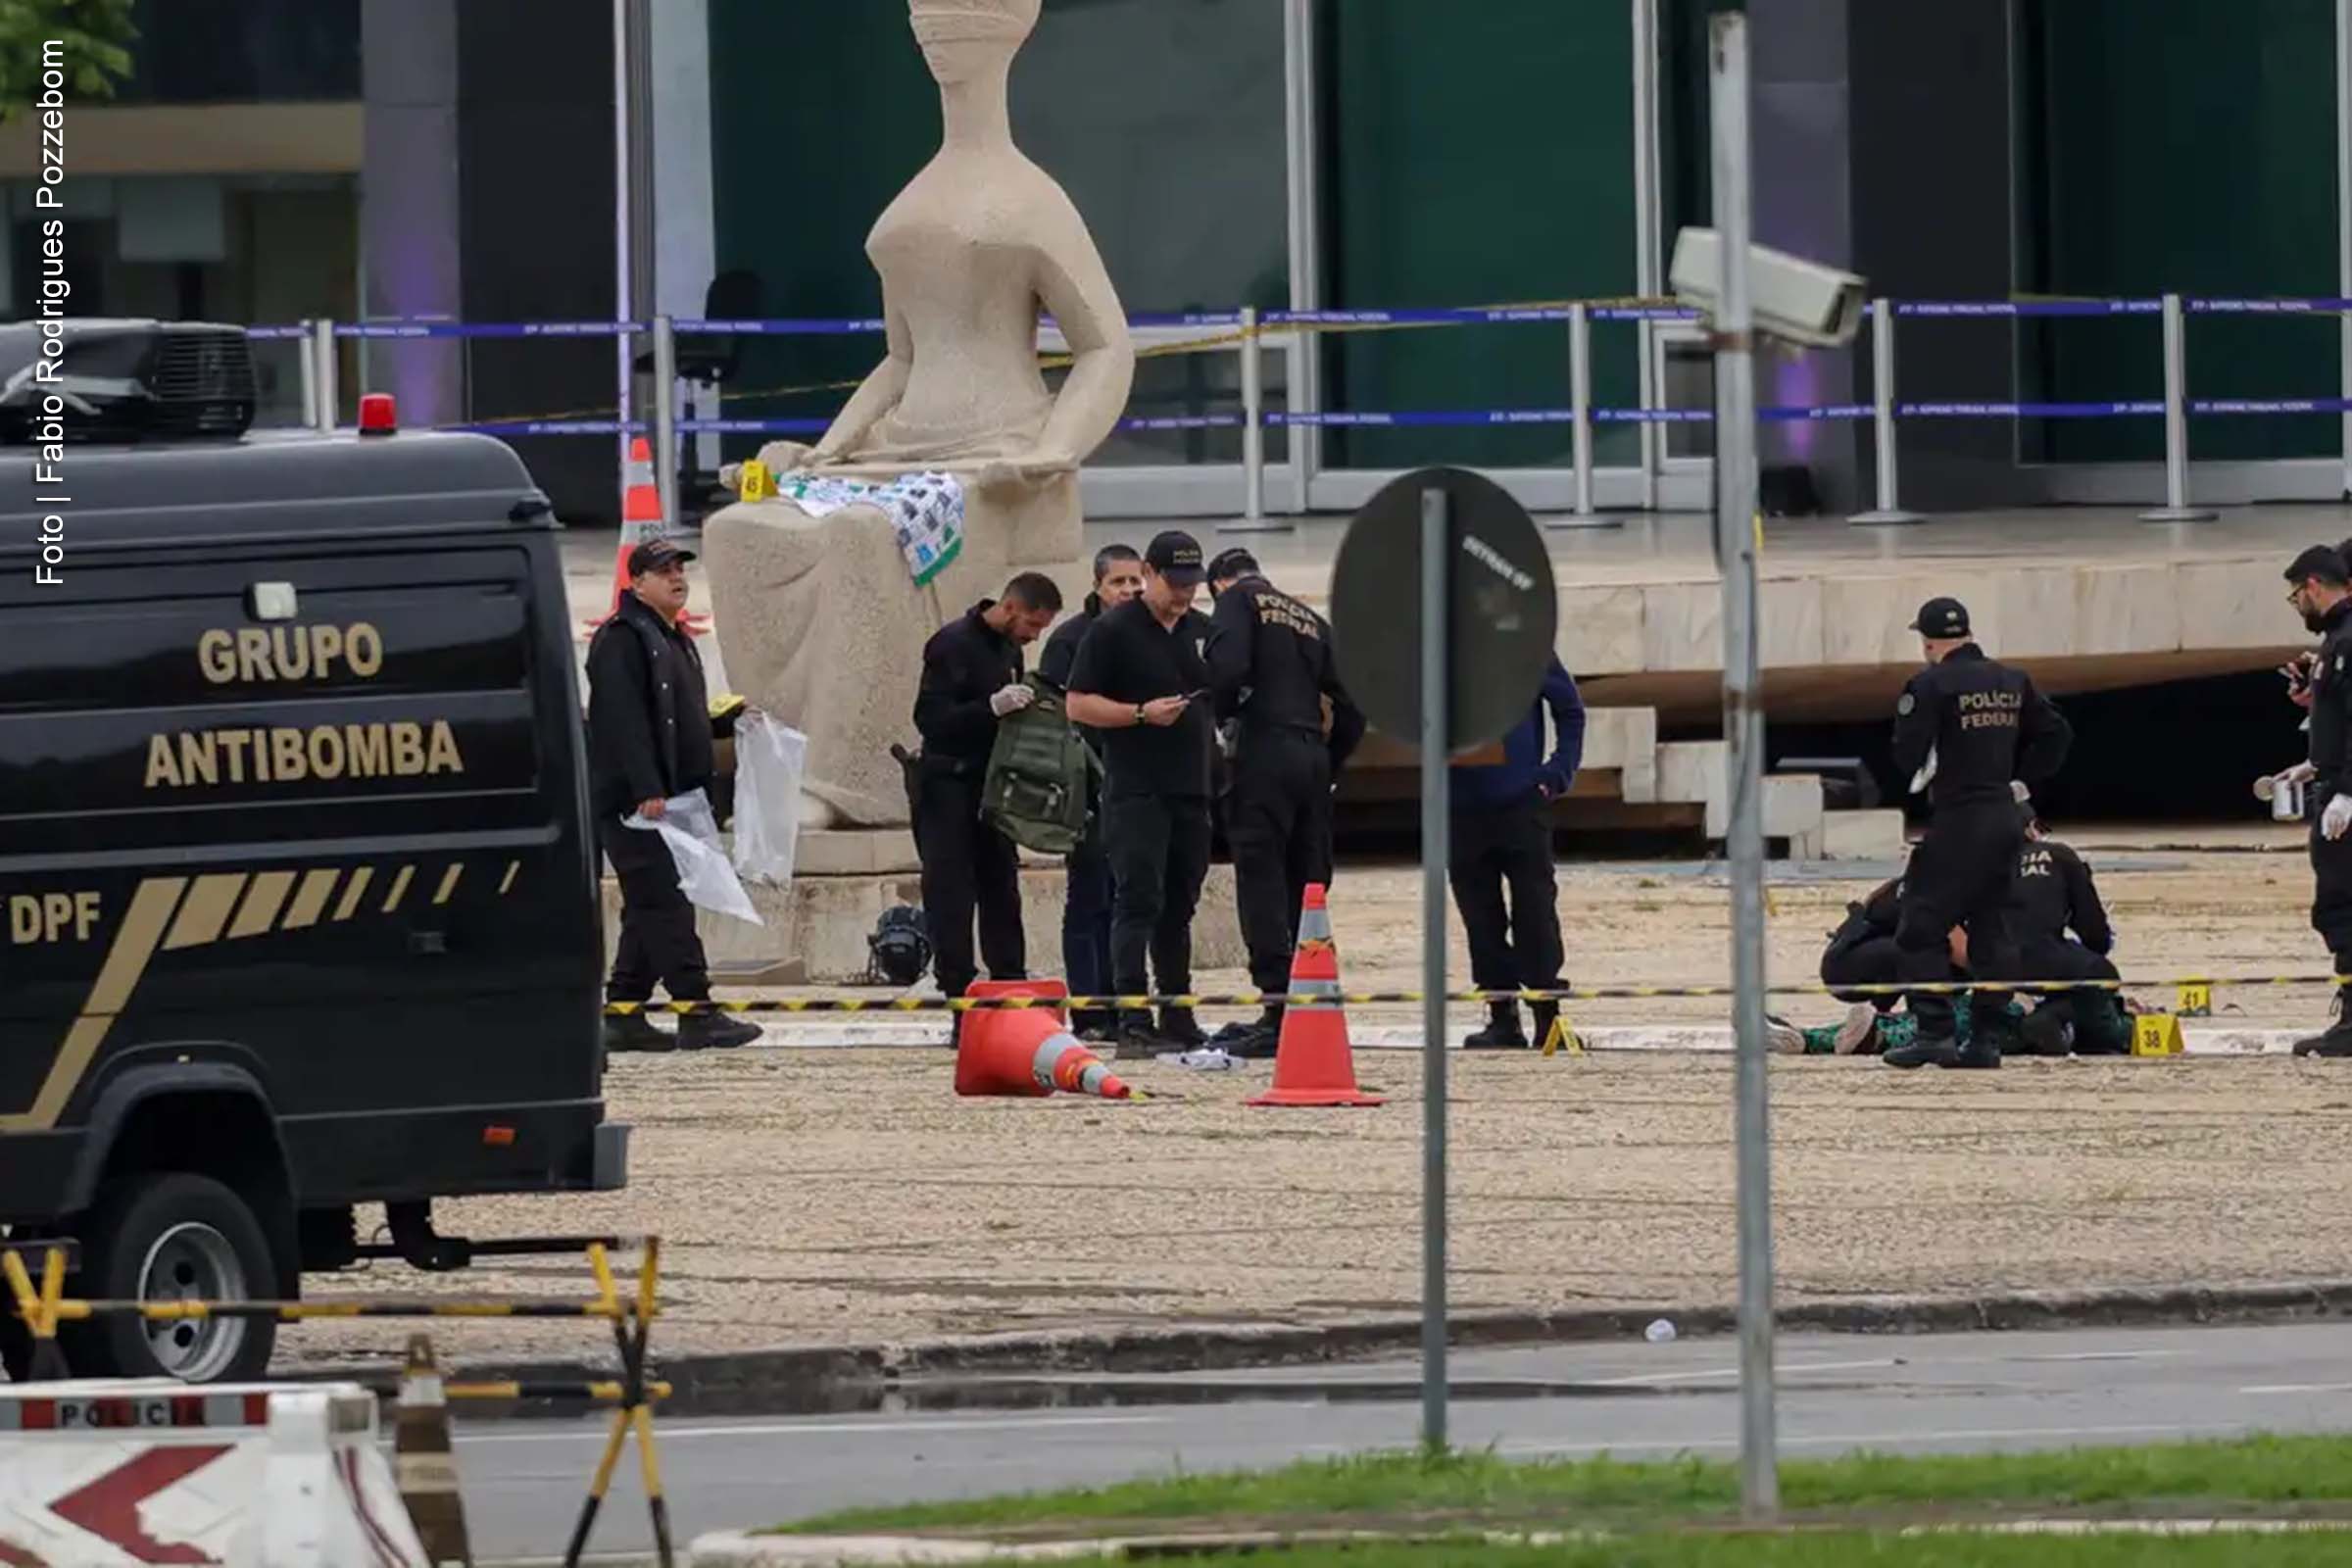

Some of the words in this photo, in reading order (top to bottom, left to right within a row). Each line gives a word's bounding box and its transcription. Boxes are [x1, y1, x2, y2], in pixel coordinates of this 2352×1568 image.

[199, 622, 383, 683] GRUPO
[145, 721, 464, 787] ANTIBOMBA
[10, 891, 102, 944] DPF
